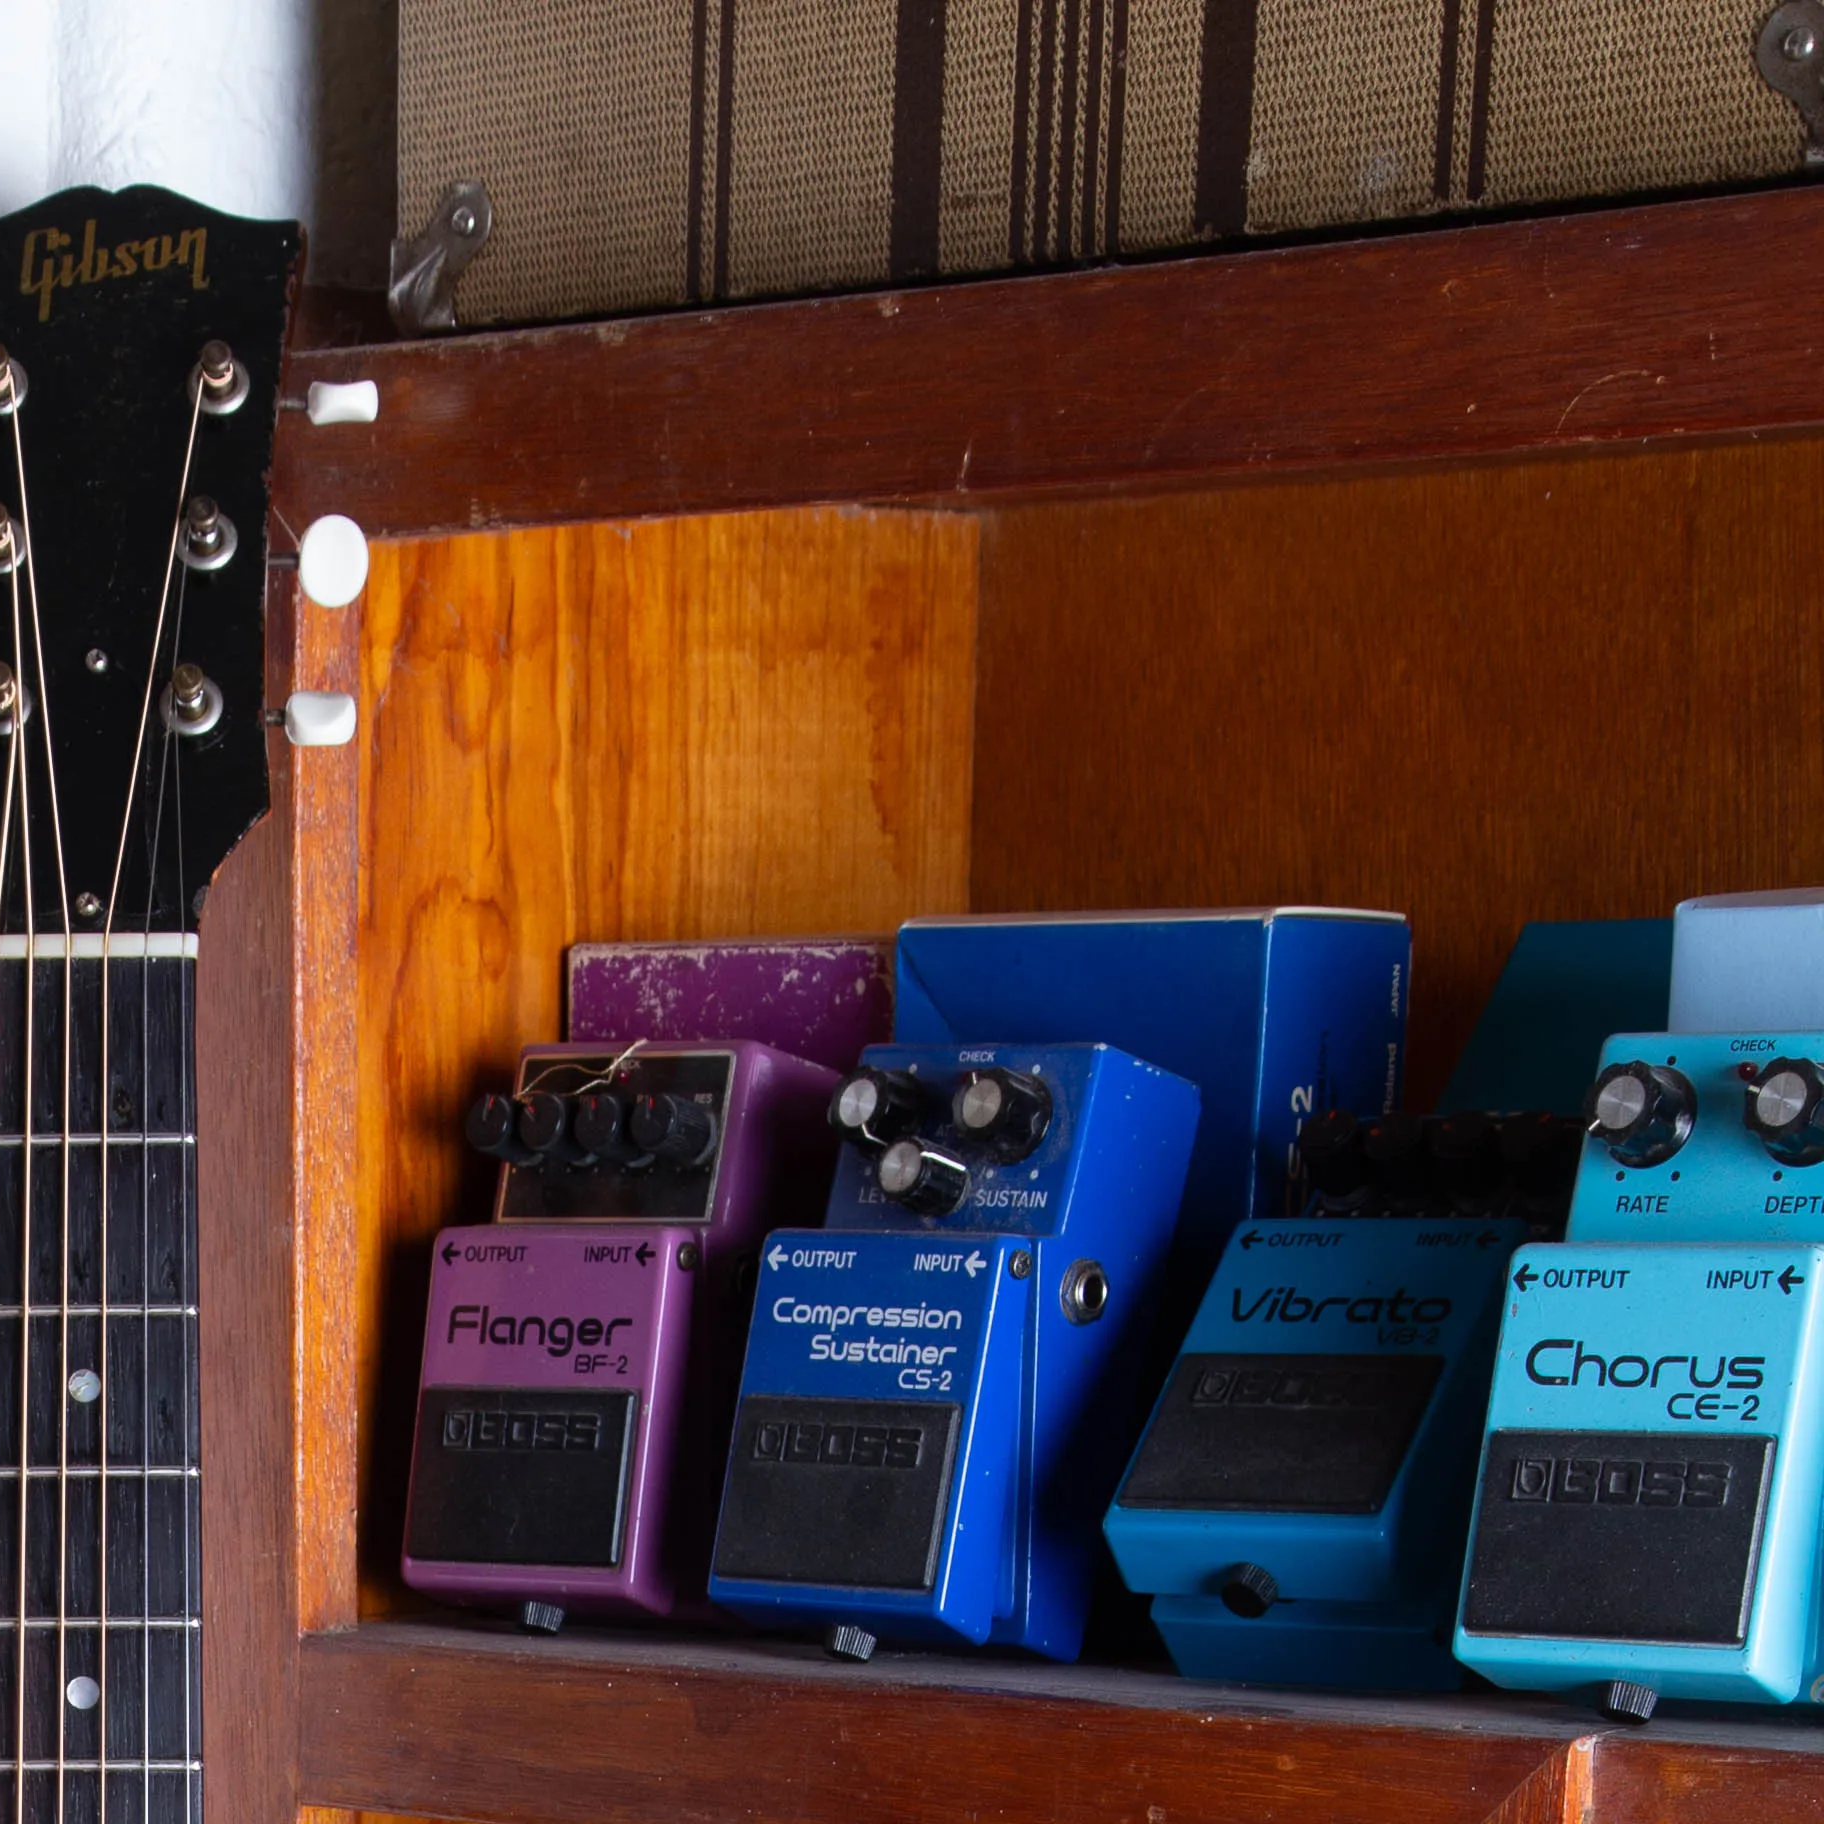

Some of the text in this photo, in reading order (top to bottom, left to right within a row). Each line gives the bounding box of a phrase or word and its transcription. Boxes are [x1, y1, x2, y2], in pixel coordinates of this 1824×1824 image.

[19, 218, 211, 323] Gibson
[1390, 963, 1401, 1017] JAPAN
[958, 1049, 996, 1063] CHECK
[1729, 1039, 1777, 1052] CHECK
[1382, 1042, 1397, 1116] Roland
[975, 1187, 1048, 1209] SUSTAIN
[1615, 1195, 1670, 1214] RATE
[1764, 1196, 1824, 1215] DEPT
[1268, 1231, 1344, 1248] OUTPUT
[1415, 1231, 1474, 1248] INPUT
[464, 1246, 528, 1263] OUTPUT
[583, 1246, 632, 1264] INPUT
[791, 1249, 857, 1270] OUTPUT
[913, 1253, 963, 1273] INPUT
[1542, 1268, 1630, 1289] OUTPUT
[1706, 1269, 1774, 1290] INPUT
[772, 1296, 963, 1332] Compression
[1230, 1286, 1453, 1324] Vibrato
[446, 1304, 633, 1358] Flanger
[1377, 1326, 1440, 1347] VB-2
[808, 1333, 957, 1367] Sustainer
[574, 1353, 629, 1375] BF-2
[1524, 1338, 1767, 1390] Chorus
[897, 1367, 953, 1392] CS-2
[1665, 1392, 1761, 1422] CE-2
[476, 1410, 602, 1450] BOSS
[784, 1422, 924, 1469] BOSS
[1556, 1458, 1733, 1507] BOSS
